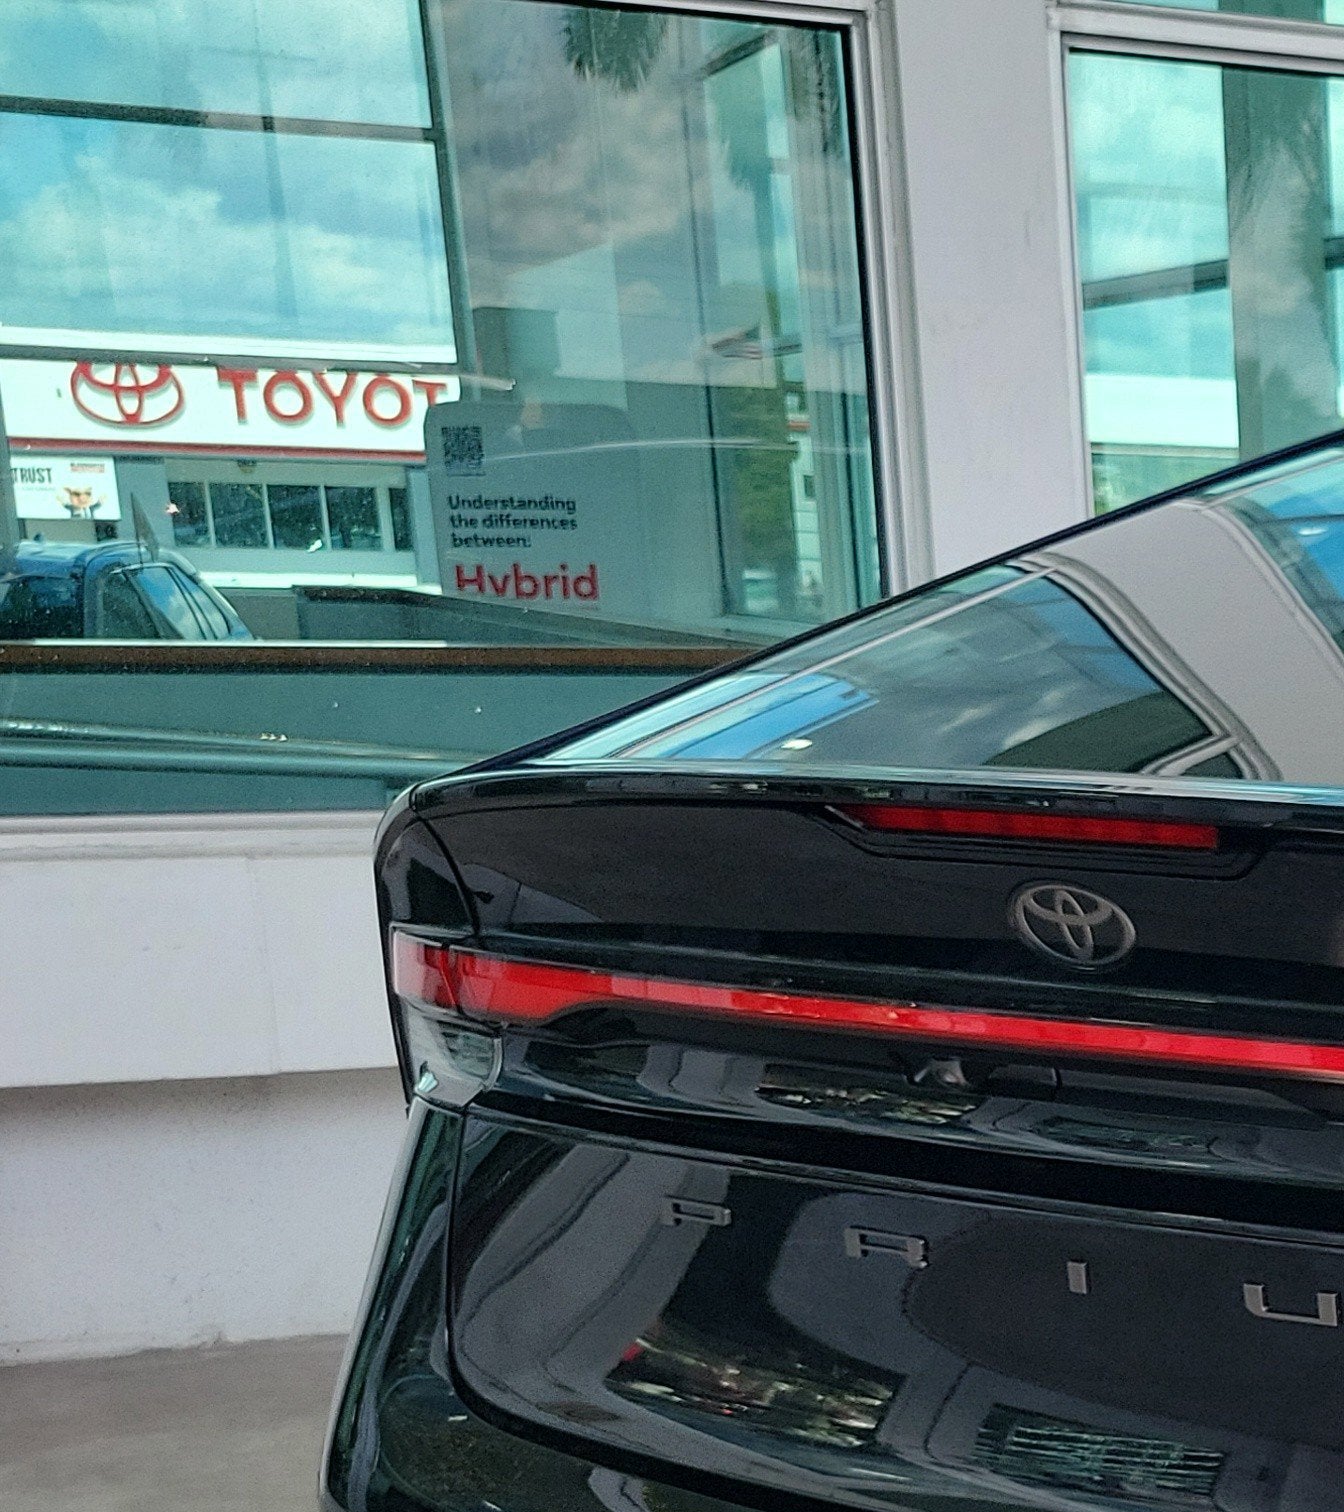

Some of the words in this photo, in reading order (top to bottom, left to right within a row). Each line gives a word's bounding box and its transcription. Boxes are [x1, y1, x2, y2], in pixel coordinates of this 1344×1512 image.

[448, 494, 577, 514] Understanding
[450, 514, 478, 529] the
[482, 513, 578, 530] differences
